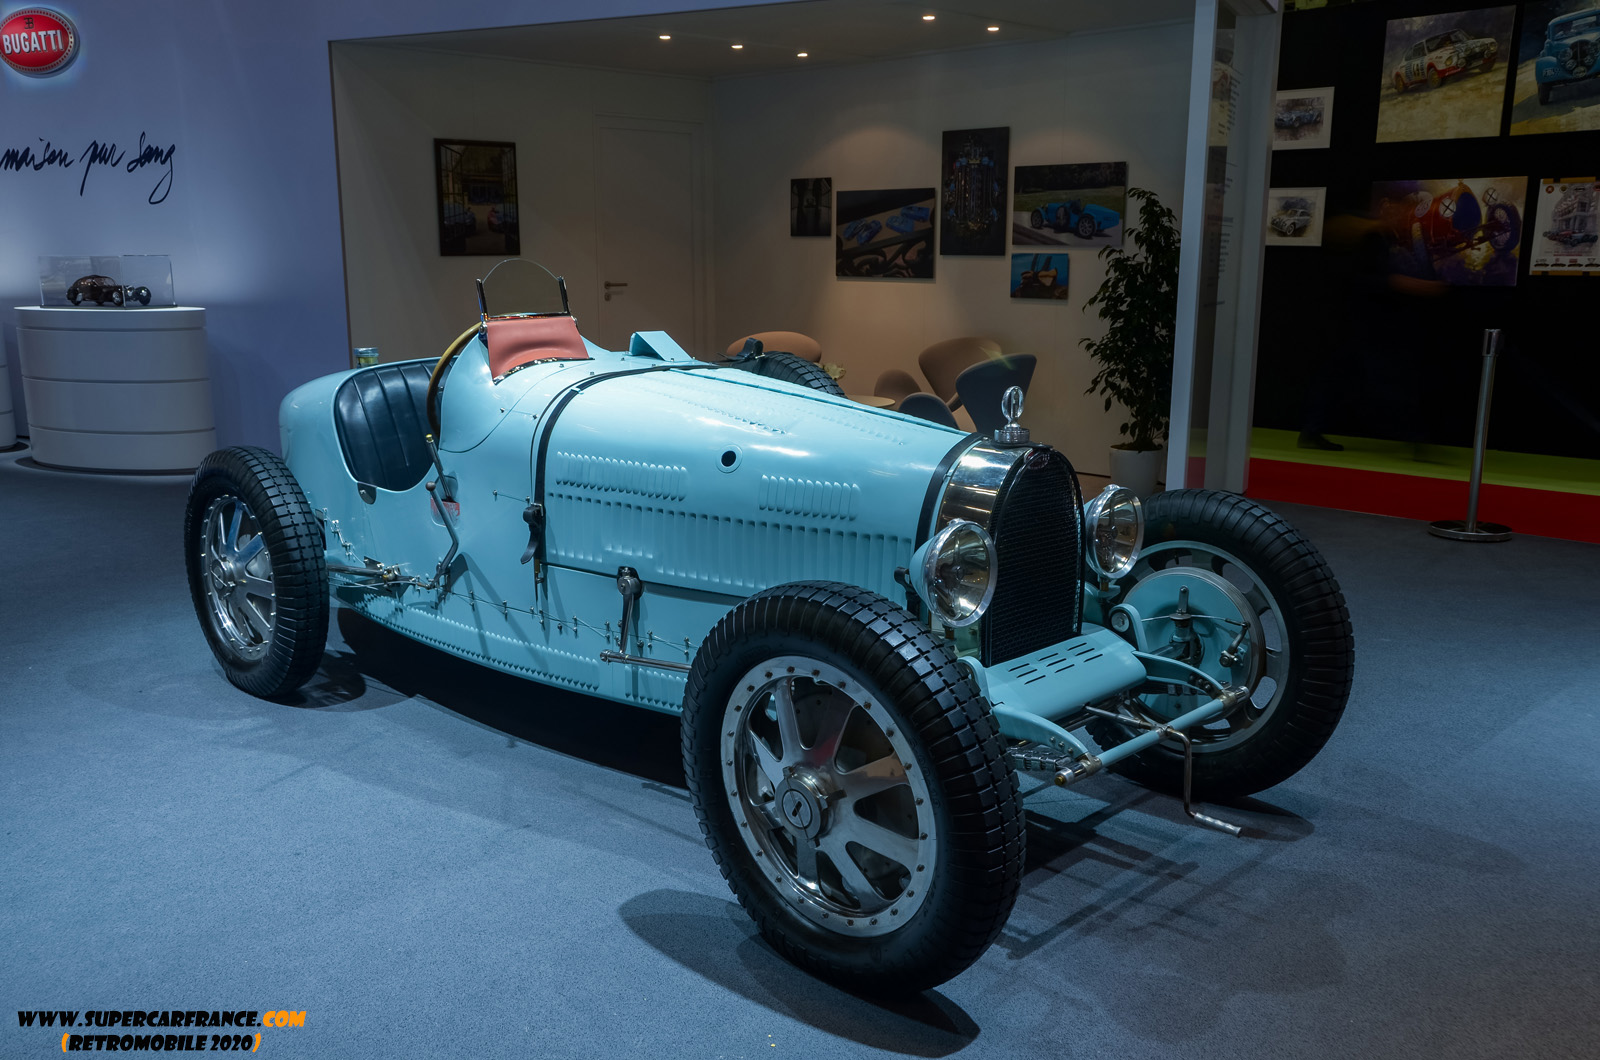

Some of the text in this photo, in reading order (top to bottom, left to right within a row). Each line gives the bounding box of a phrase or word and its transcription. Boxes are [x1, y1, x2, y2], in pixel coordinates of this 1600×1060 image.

[3, 30, 65, 54] BUGATTI
[0, 137, 75, 170] maison
[79, 140, 126, 197] pur
